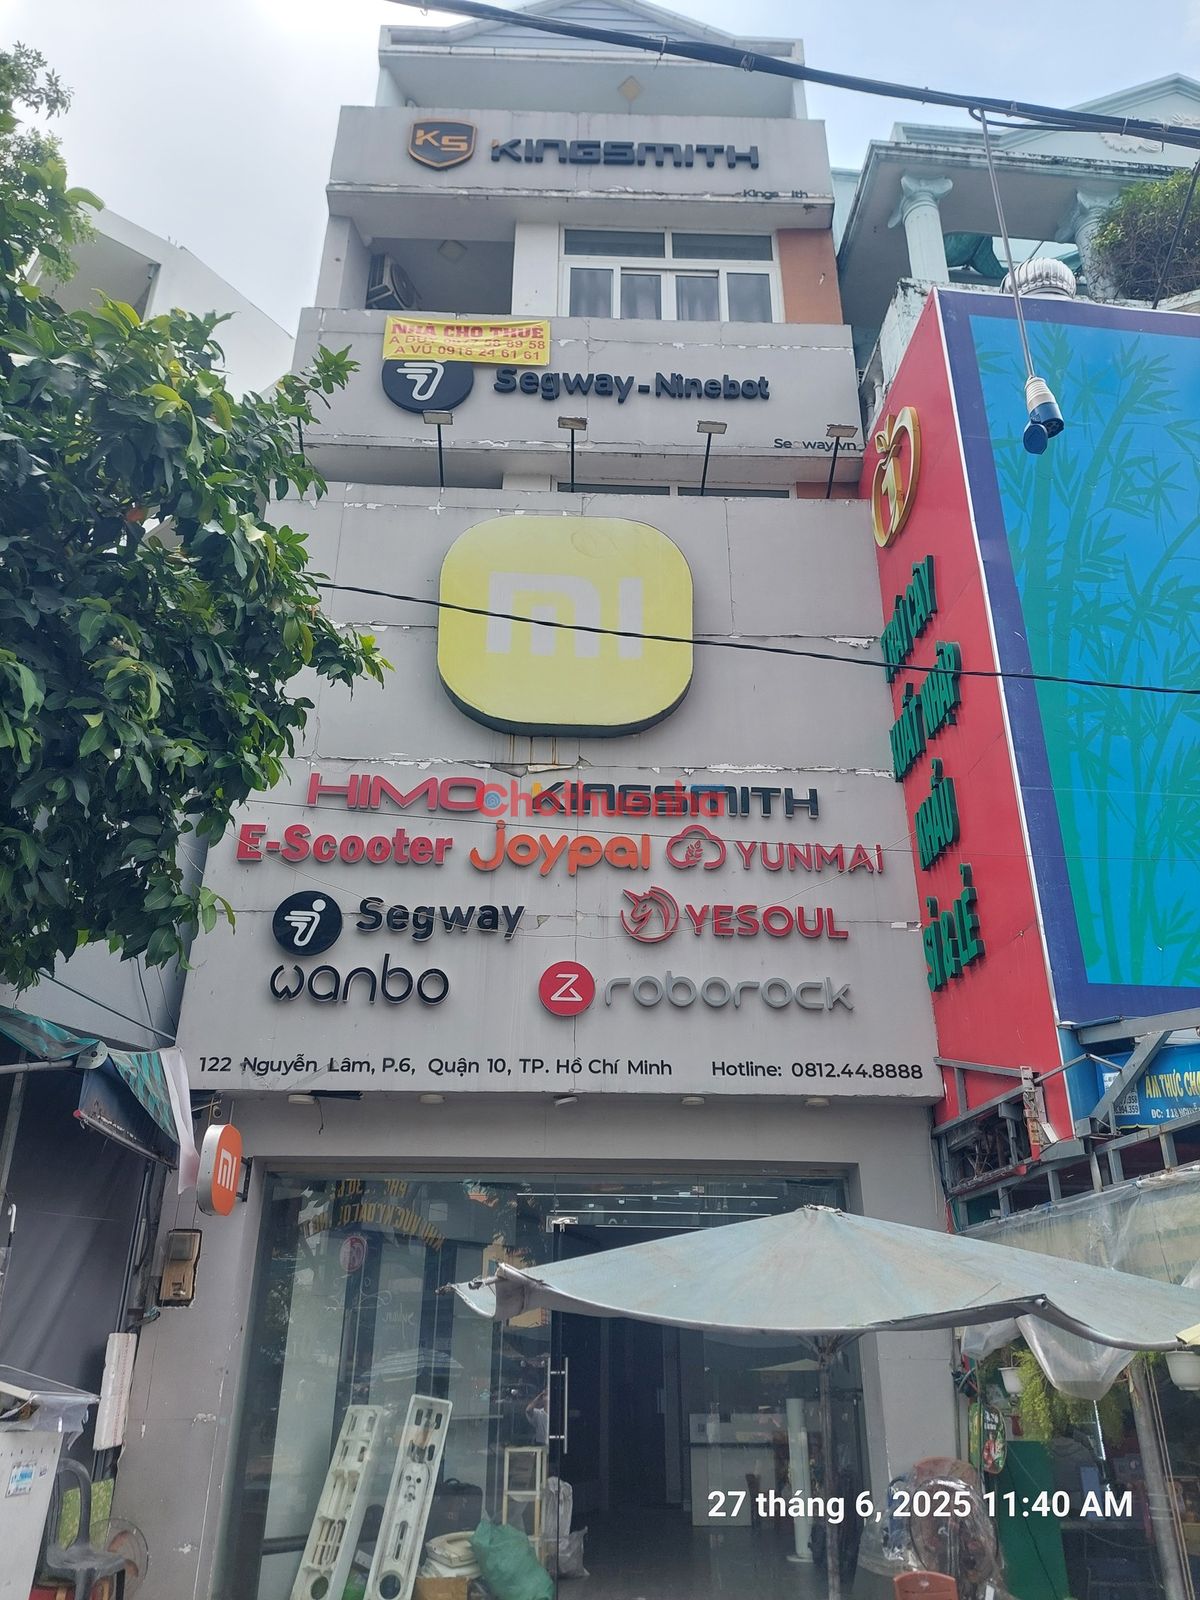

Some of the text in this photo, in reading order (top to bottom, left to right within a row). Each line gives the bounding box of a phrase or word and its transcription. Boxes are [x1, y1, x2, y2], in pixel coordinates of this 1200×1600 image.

[415, 129, 468, 151] KS
[491, 138, 759, 170] KINGSMITH
[443, 325, 483, 338] CHO
[528, 340, 545, 350] 58
[394, 345, 405, 355] A
[411, 343, 431, 355] VŨ
[501, 349, 517, 360] 61
[523, 351, 539, 361] 61
[306, 772, 487, 812] HIMO
[532, 781, 820, 819] KINGSMITH
[236, 823, 454, 866] E-Scooter
[736, 839, 887, 874] YUNMAI
[355, 896, 526, 943] Segway
[684, 903, 849, 940] YESOUL
[269, 953, 451, 1006] wanbo
[604, 970, 855, 1013] roborock
[199, 1053, 673, 1078] 122 Nguyễn Lâm, P.6, Quận 10, TP. Hồ Chí Minh
[711, 1061, 924, 1080] Hotline: 0812.44.8888
